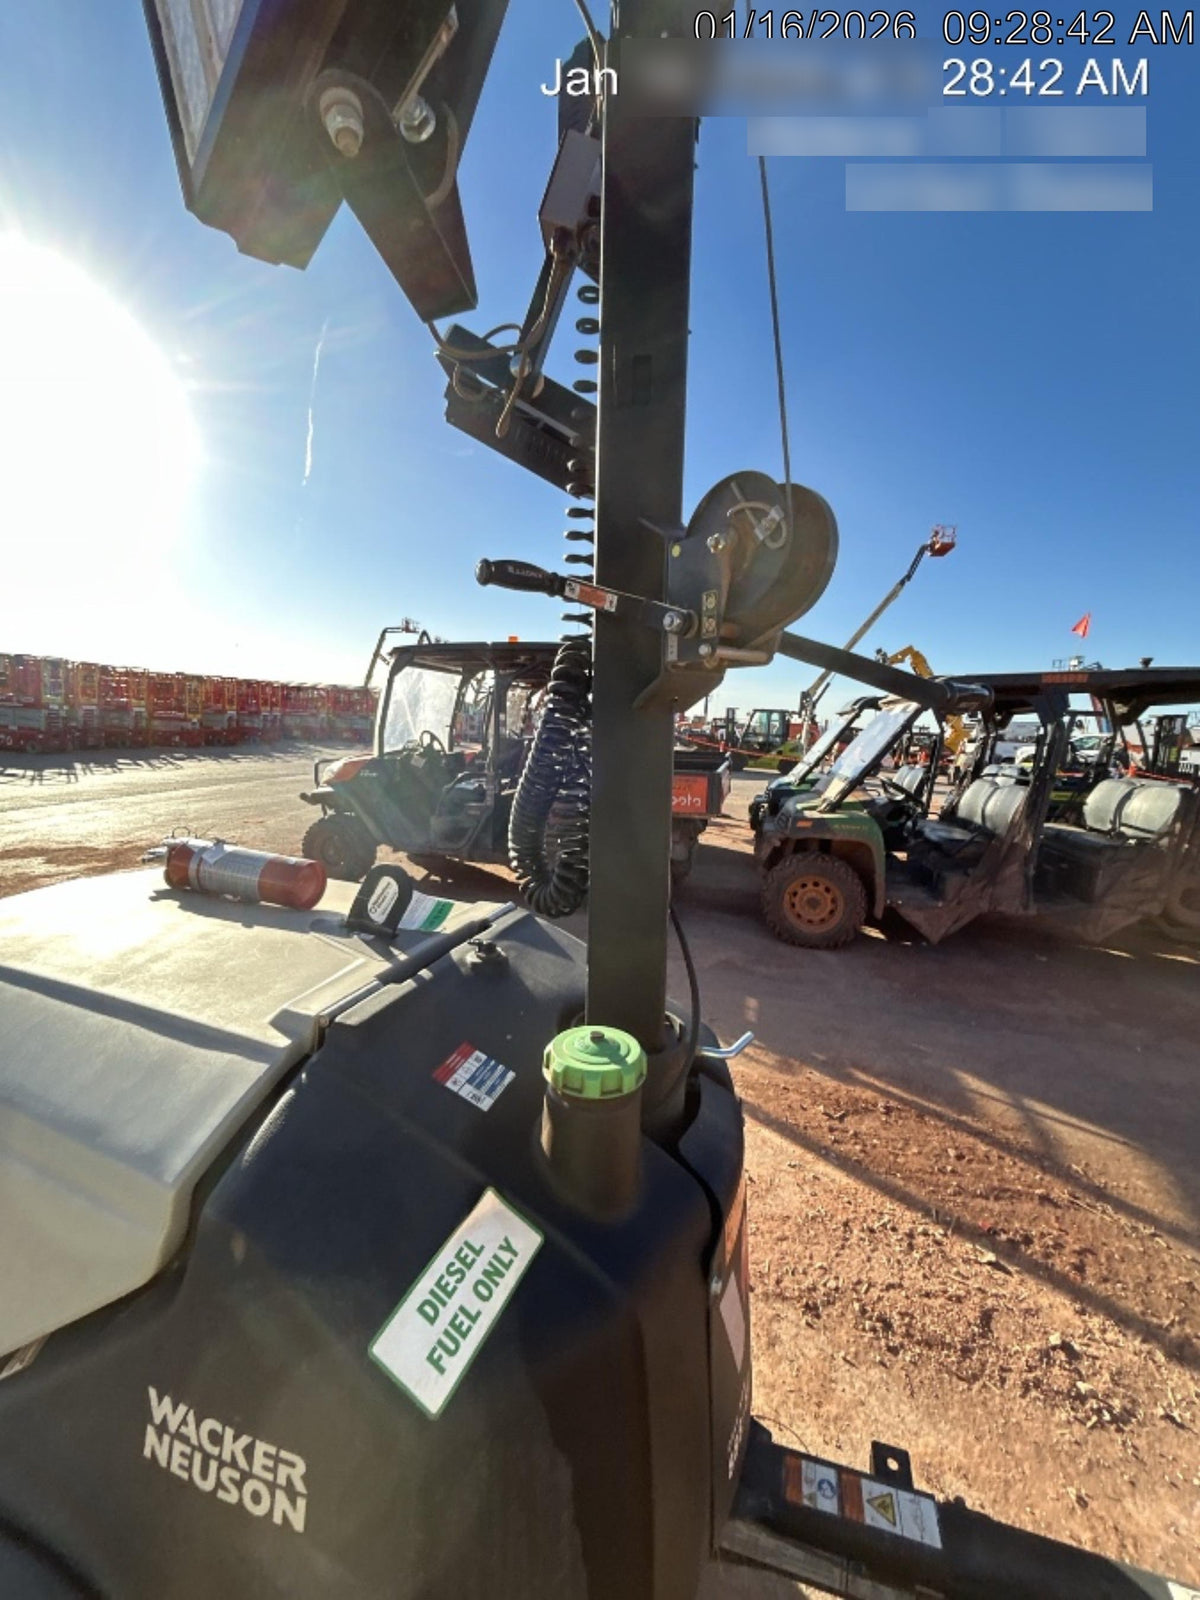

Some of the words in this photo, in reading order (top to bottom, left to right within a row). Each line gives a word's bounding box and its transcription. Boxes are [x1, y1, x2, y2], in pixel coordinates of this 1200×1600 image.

[416, 1240, 486, 1326] DIESEL
[426, 1304, 482, 1375] FUEL
[472, 1235, 519, 1302] ONLY
[143, 1423, 307, 1533] NEUSON
[148, 1385, 308, 1494] WACKER
